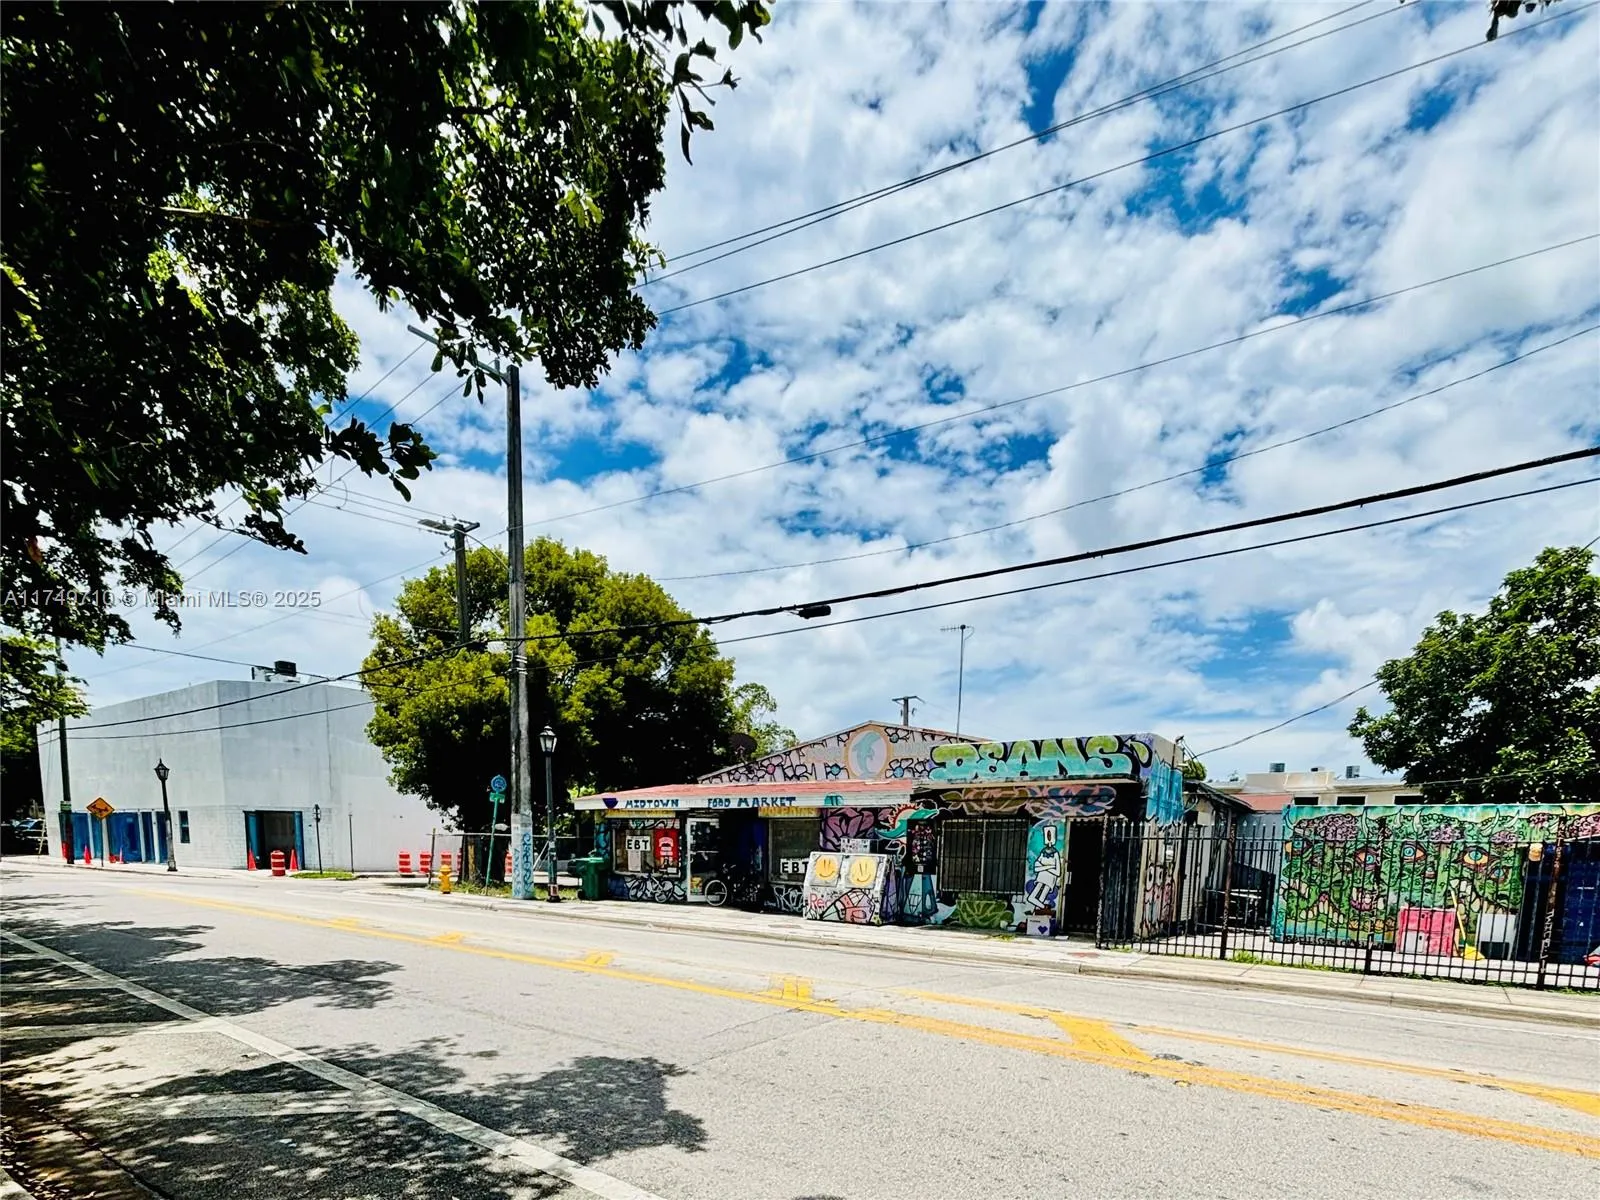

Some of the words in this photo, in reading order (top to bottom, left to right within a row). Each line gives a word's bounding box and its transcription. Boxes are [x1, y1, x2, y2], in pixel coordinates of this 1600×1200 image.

[625, 799, 679, 808] MIDTOWN
[707, 797, 731, 807] FOOD
[737, 796, 797, 807] MARKET
[627, 839, 650, 849] EBT
[782, 861, 809, 873] EBT
